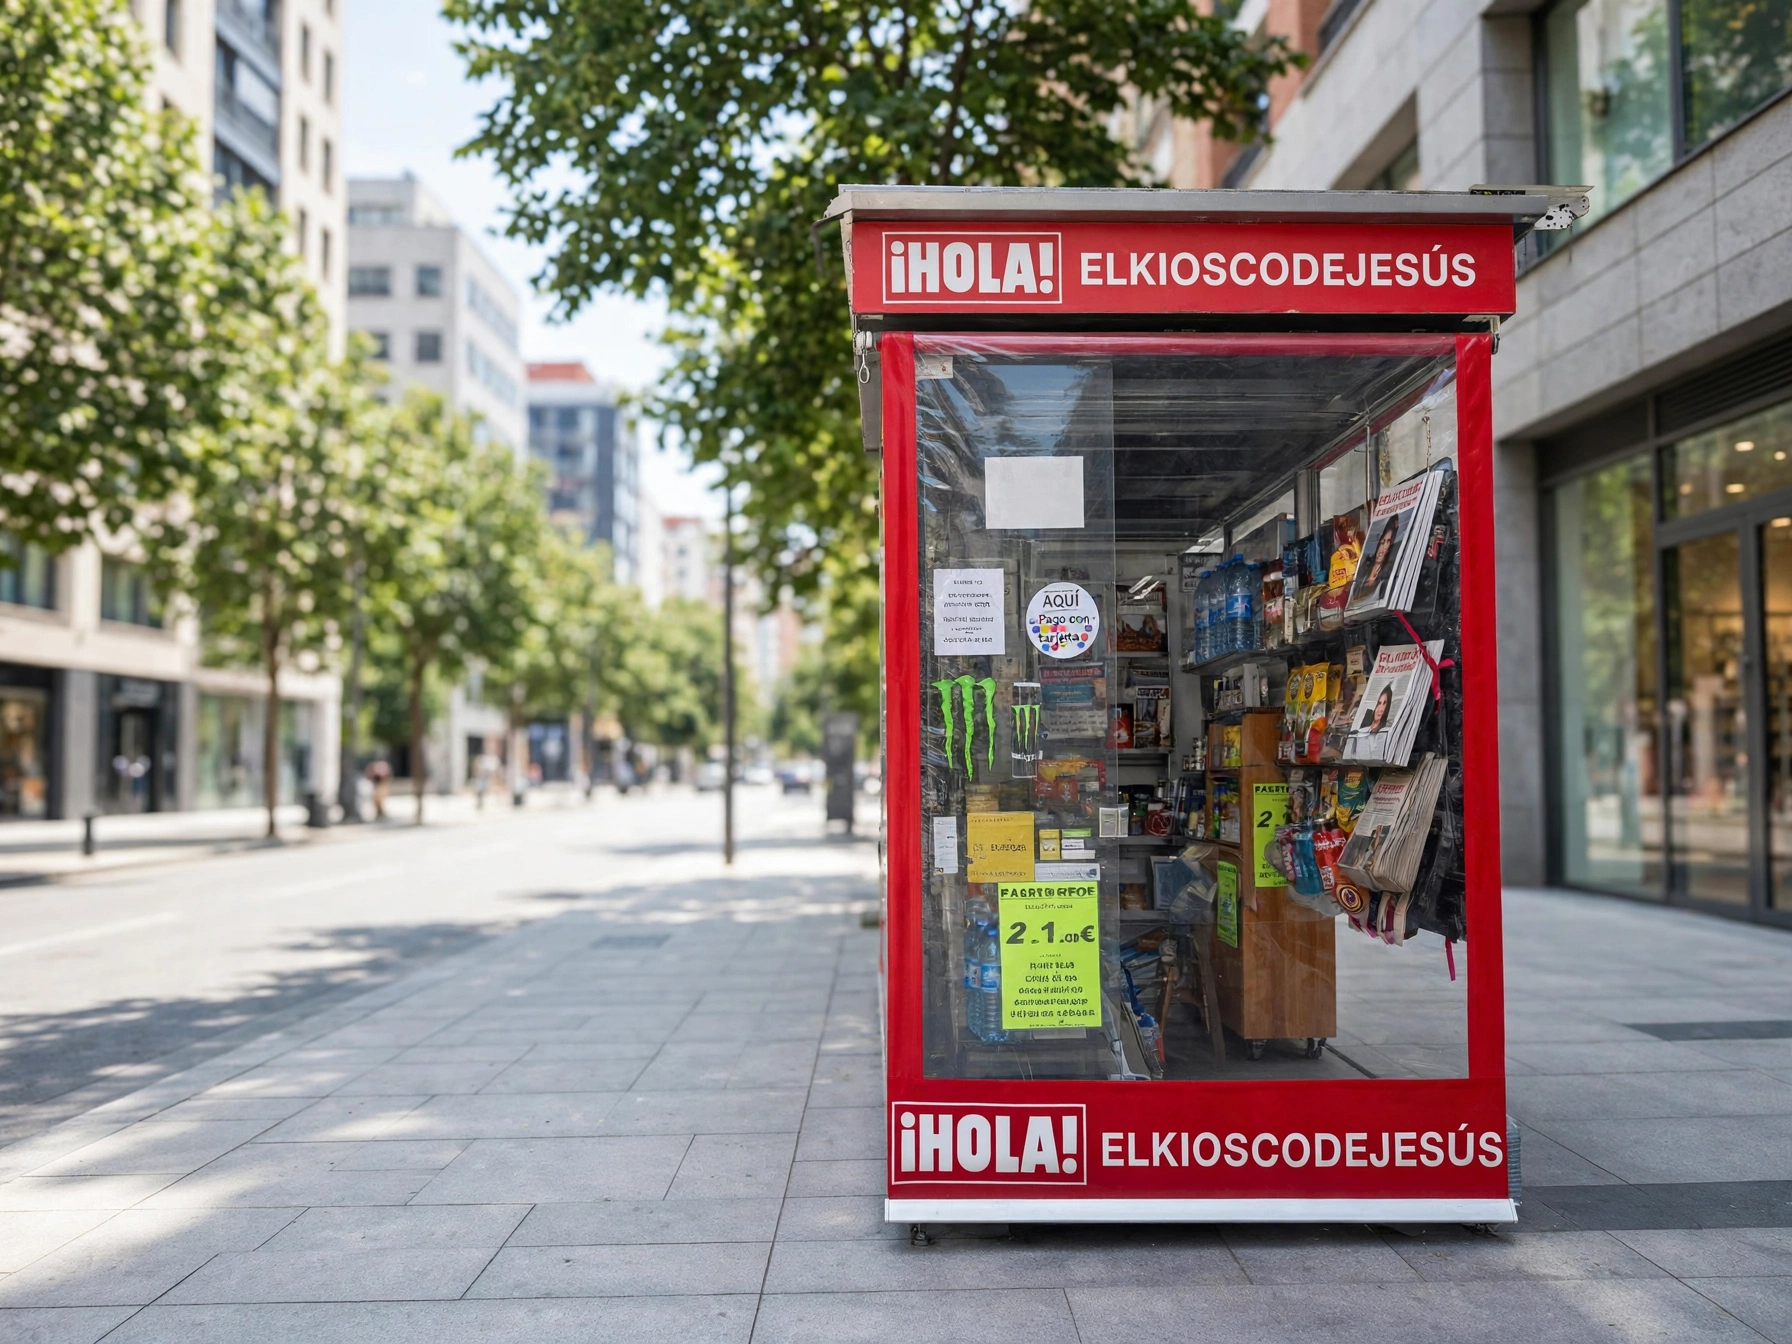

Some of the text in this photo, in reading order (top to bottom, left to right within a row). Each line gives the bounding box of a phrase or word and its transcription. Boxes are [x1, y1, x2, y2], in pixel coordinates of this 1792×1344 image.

[890, 241, 1477, 294] ¡HOLA! ELKIOSCODEJESÚS
[1043, 589, 1079, 608] AQUÍ
[1038, 614, 1090, 626] Pago con
[900, 1111, 1504, 1174] ¡HOLA! ELKIOSCODEJESÚS
